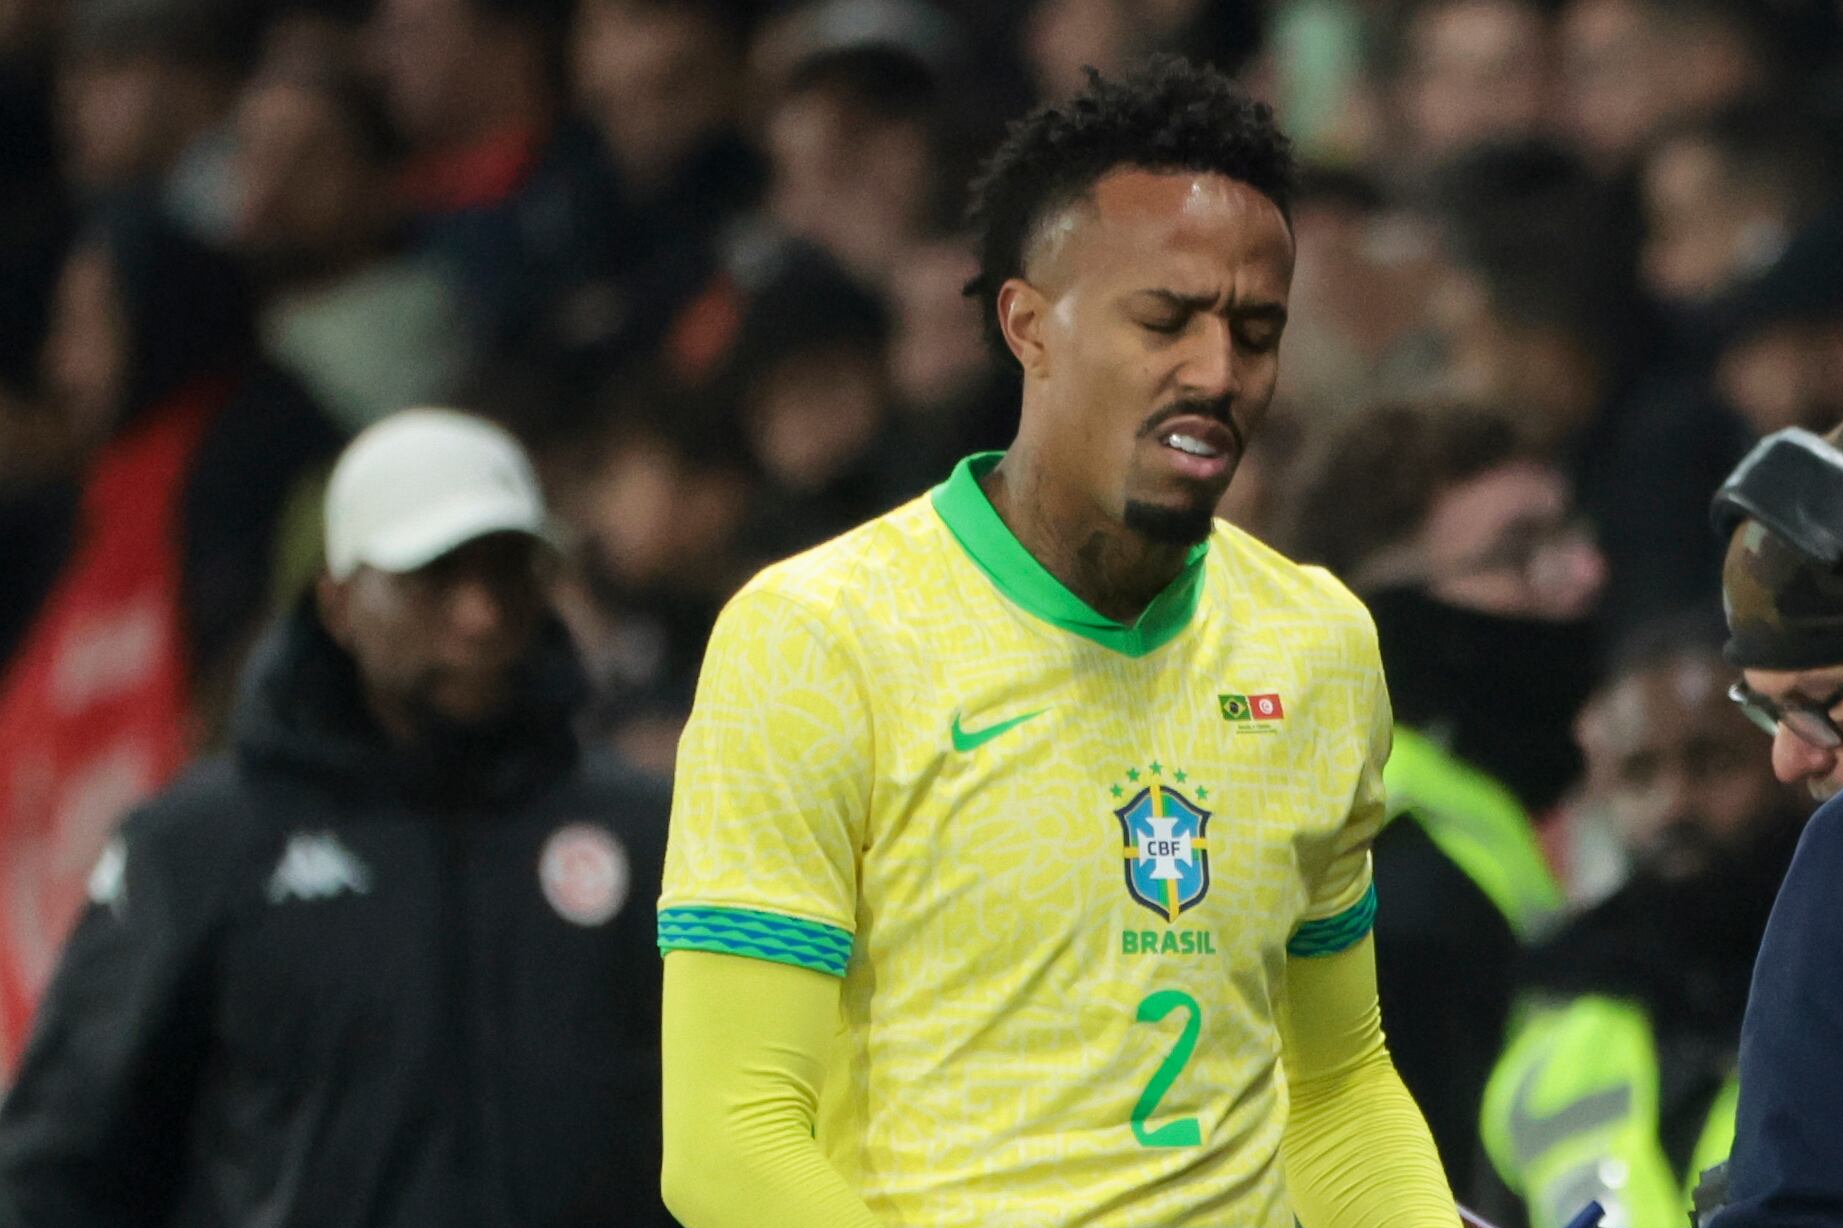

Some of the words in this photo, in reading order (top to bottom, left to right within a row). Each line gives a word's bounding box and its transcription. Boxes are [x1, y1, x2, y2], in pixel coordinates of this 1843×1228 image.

[1147, 841, 1180, 857] CBF
[1121, 930, 1216, 955] BRASIL
[1130, 989, 1202, 1147] 2
